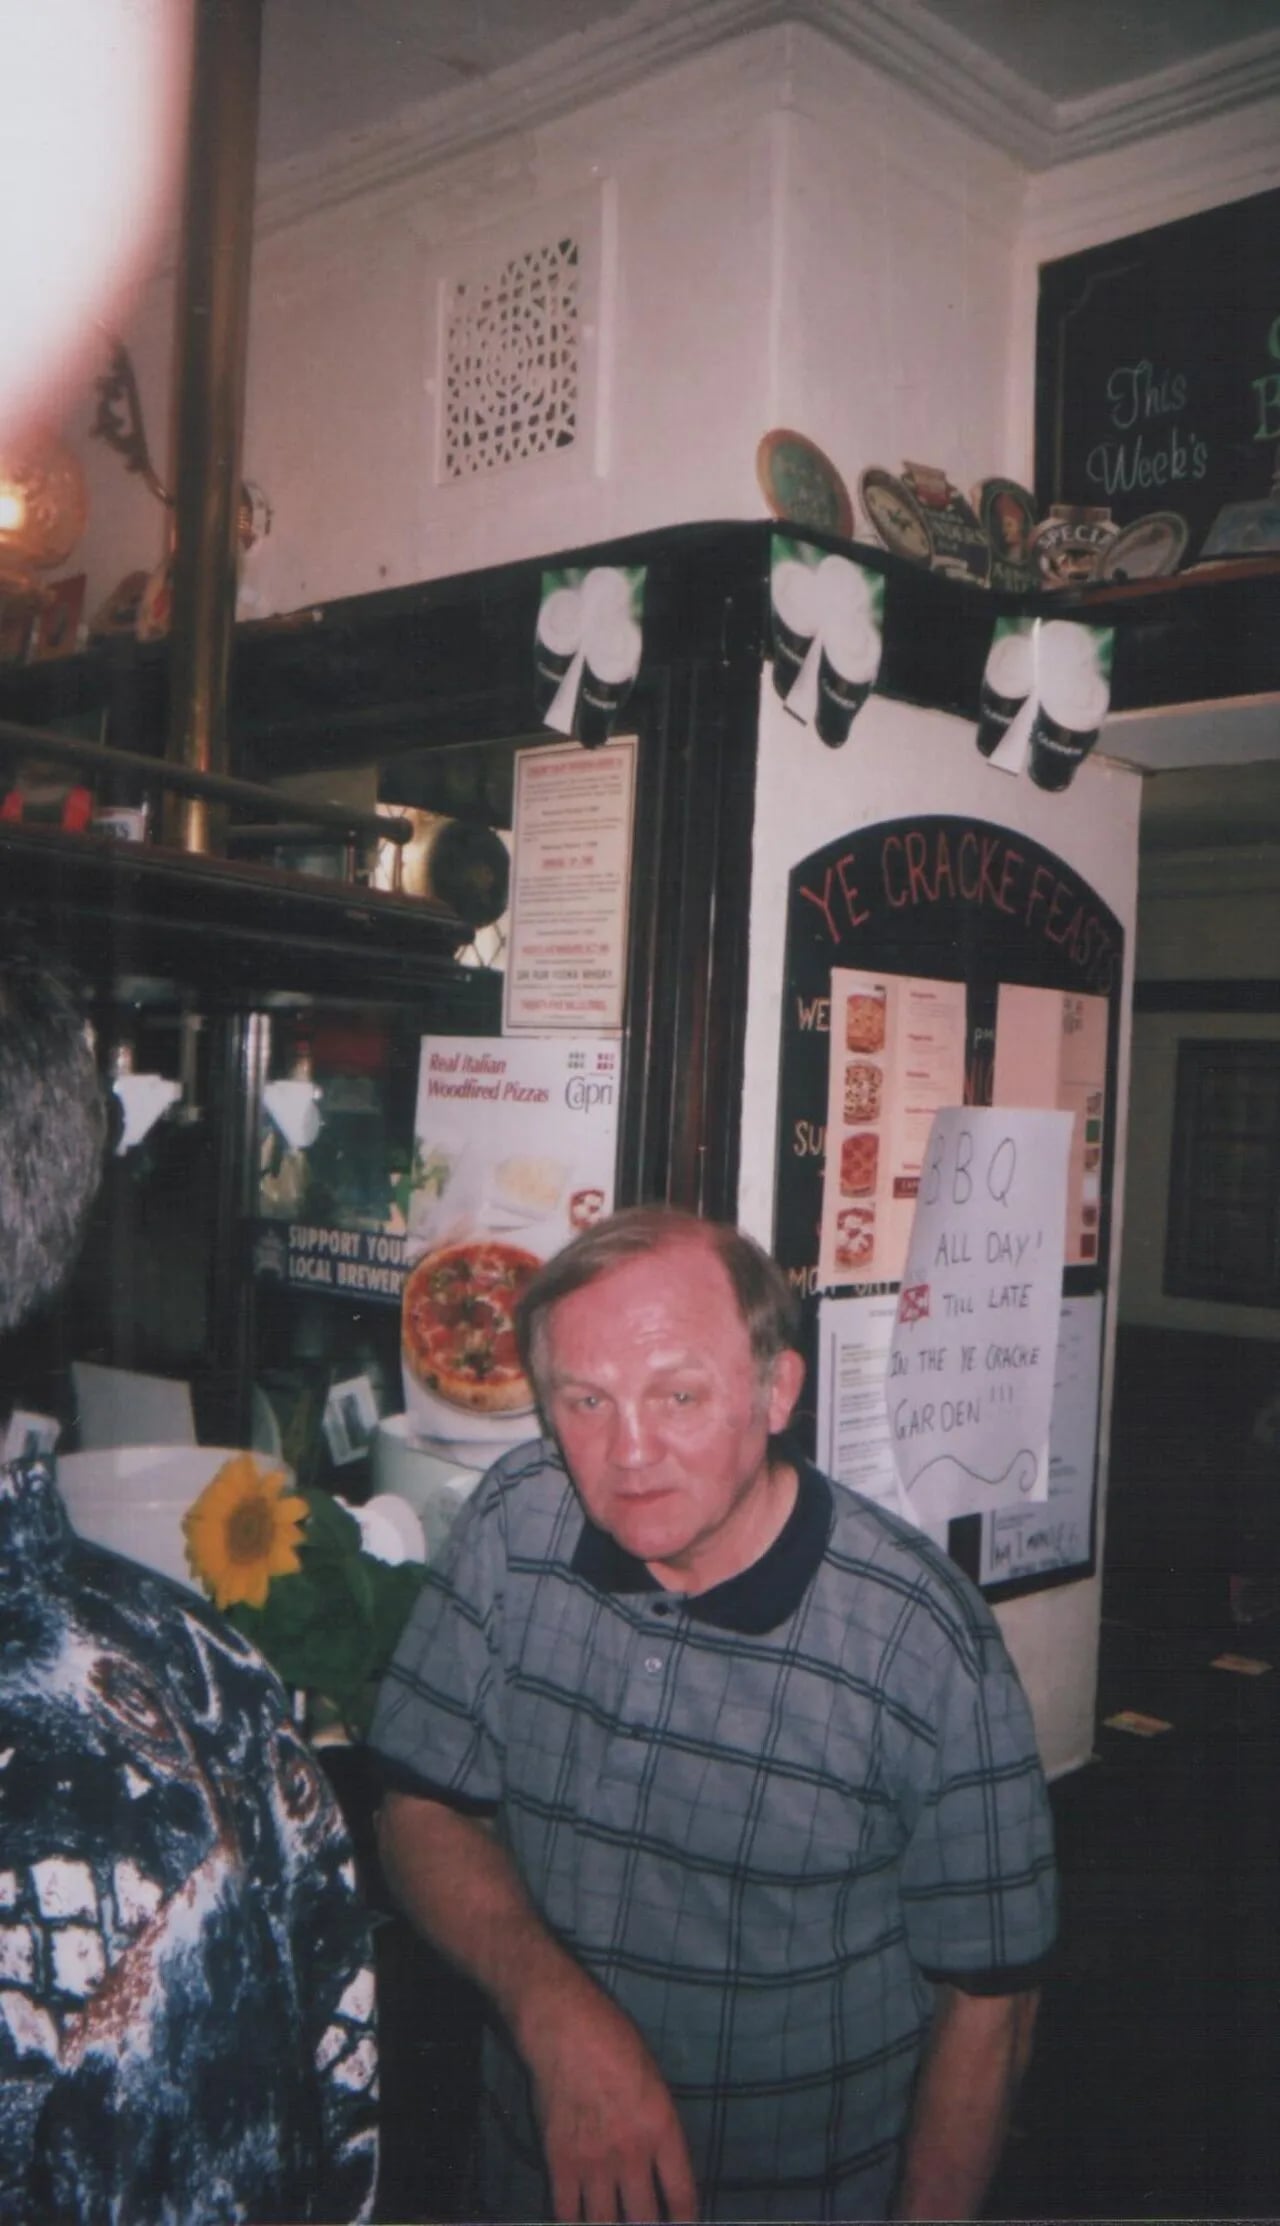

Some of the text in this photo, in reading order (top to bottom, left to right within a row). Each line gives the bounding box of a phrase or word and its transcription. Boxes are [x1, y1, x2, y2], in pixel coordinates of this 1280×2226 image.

[1107, 358, 1187, 429] This
[1086, 427, 1209, 496] Week's
[801, 853, 870, 944] YE
[882, 831, 1025, 914] CRACKE
[428, 1053, 507, 1074] Real Italian
[428, 1078, 550, 1103] Woodfired Pizzas
[564, 1074, 615, 1114] Capri
[288, 1225, 361, 1258] SUPPORT
[934, 1230, 1044, 1268] ALL DAY!
[288, 1255, 406, 1296] LOCAL BREWER
[986, 1284, 1034, 1311] LATE
[917, 1347, 948, 1374] THE
[961, 1345, 978, 1374] YE
[985, 1344, 1042, 1370] CRACKE
